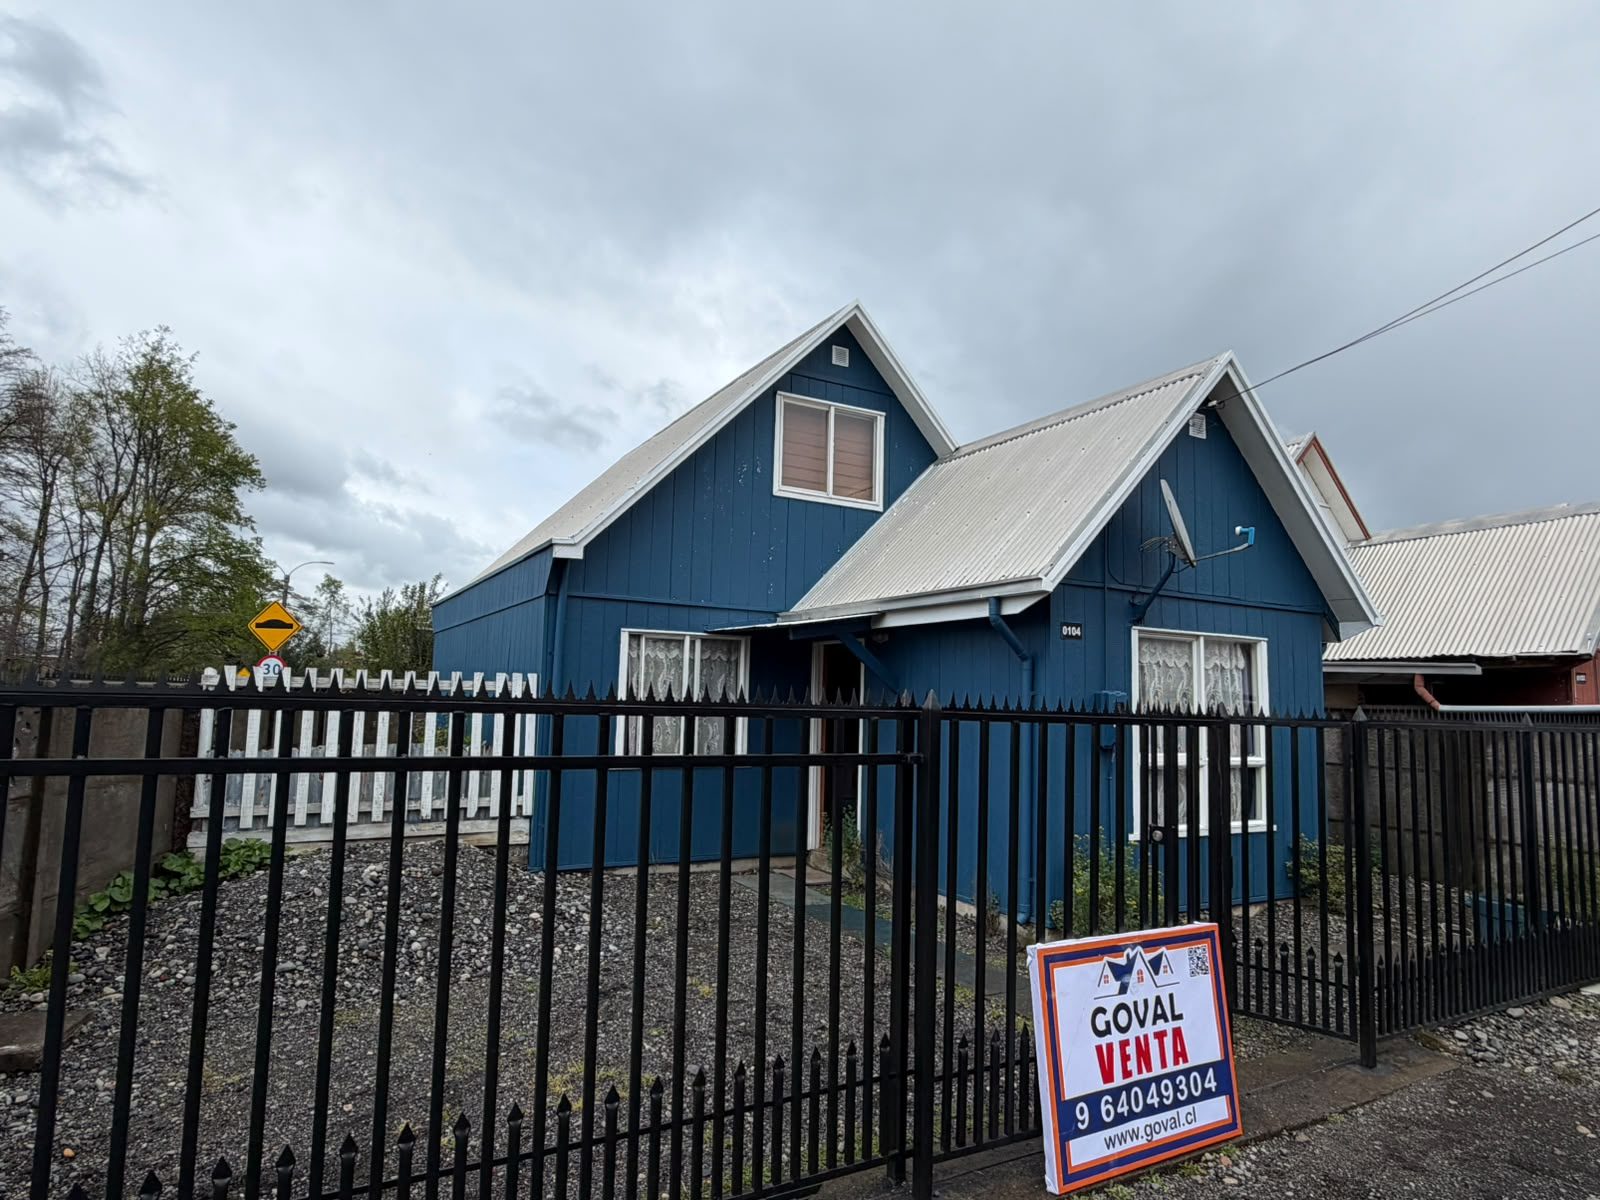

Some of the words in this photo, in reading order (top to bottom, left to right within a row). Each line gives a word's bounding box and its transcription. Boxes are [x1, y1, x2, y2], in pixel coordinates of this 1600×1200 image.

[1062, 625, 1081, 636] 0104
[263, 663, 280, 675] 30
[1091, 992, 1184, 1038] GOVAL
[1095, 1026, 1189, 1085] VENTA
[1075, 1102, 1090, 1130] 9
[1101, 1067, 1217, 1123] 64049304
[1104, 1106, 1197, 1150] www.goval.cl
